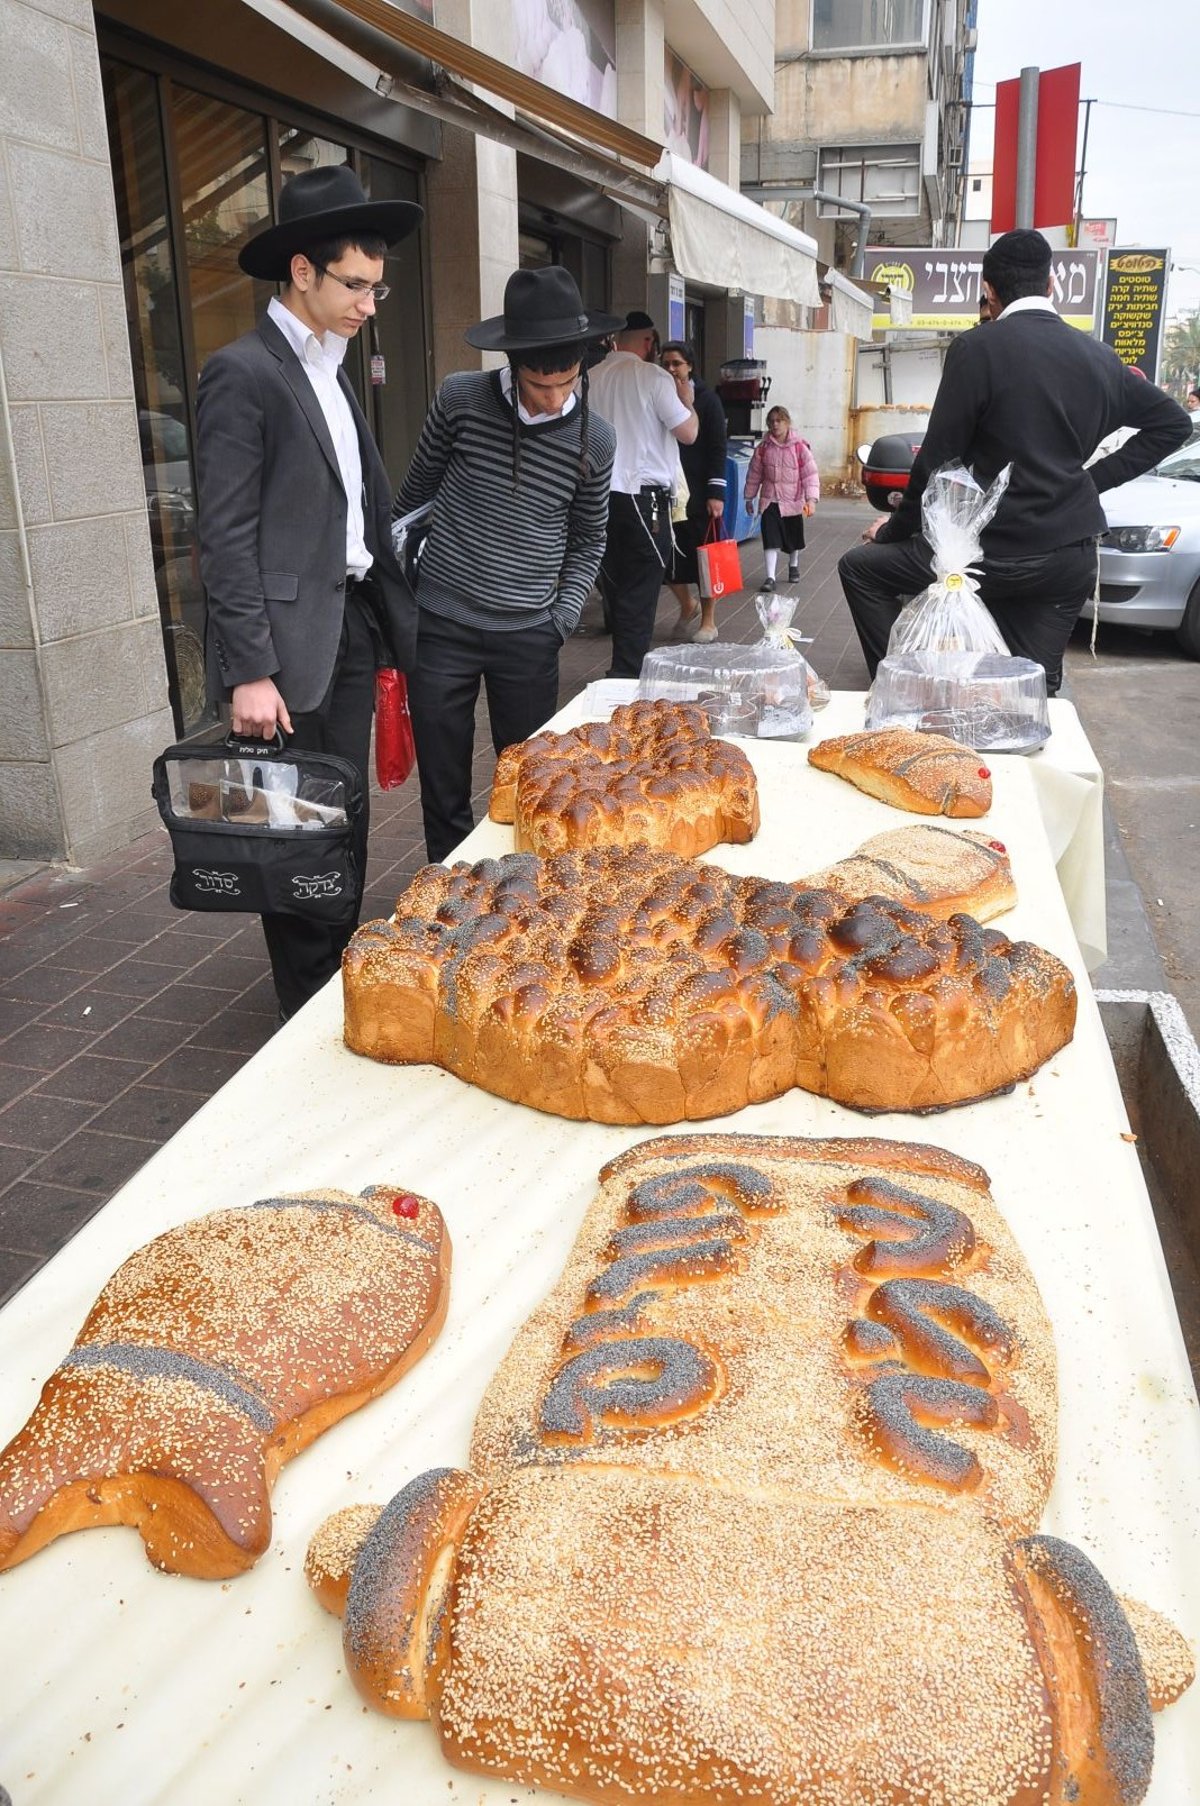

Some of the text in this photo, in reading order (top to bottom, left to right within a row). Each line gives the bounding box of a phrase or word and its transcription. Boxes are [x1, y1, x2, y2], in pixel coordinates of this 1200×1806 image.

[924, 261, 983, 303] הצבי
[1120, 276, 1151, 284] טוסטים
[1112, 284, 1157, 294] שתיה קרה
[1132, 294, 1157, 302] שתיה
[1108, 304, 1122, 312] ירק
[1114, 312, 1151, 320] שקשוקה
[199, 874, 234, 888] סדור
[297, 878, 336, 896] צדקה
